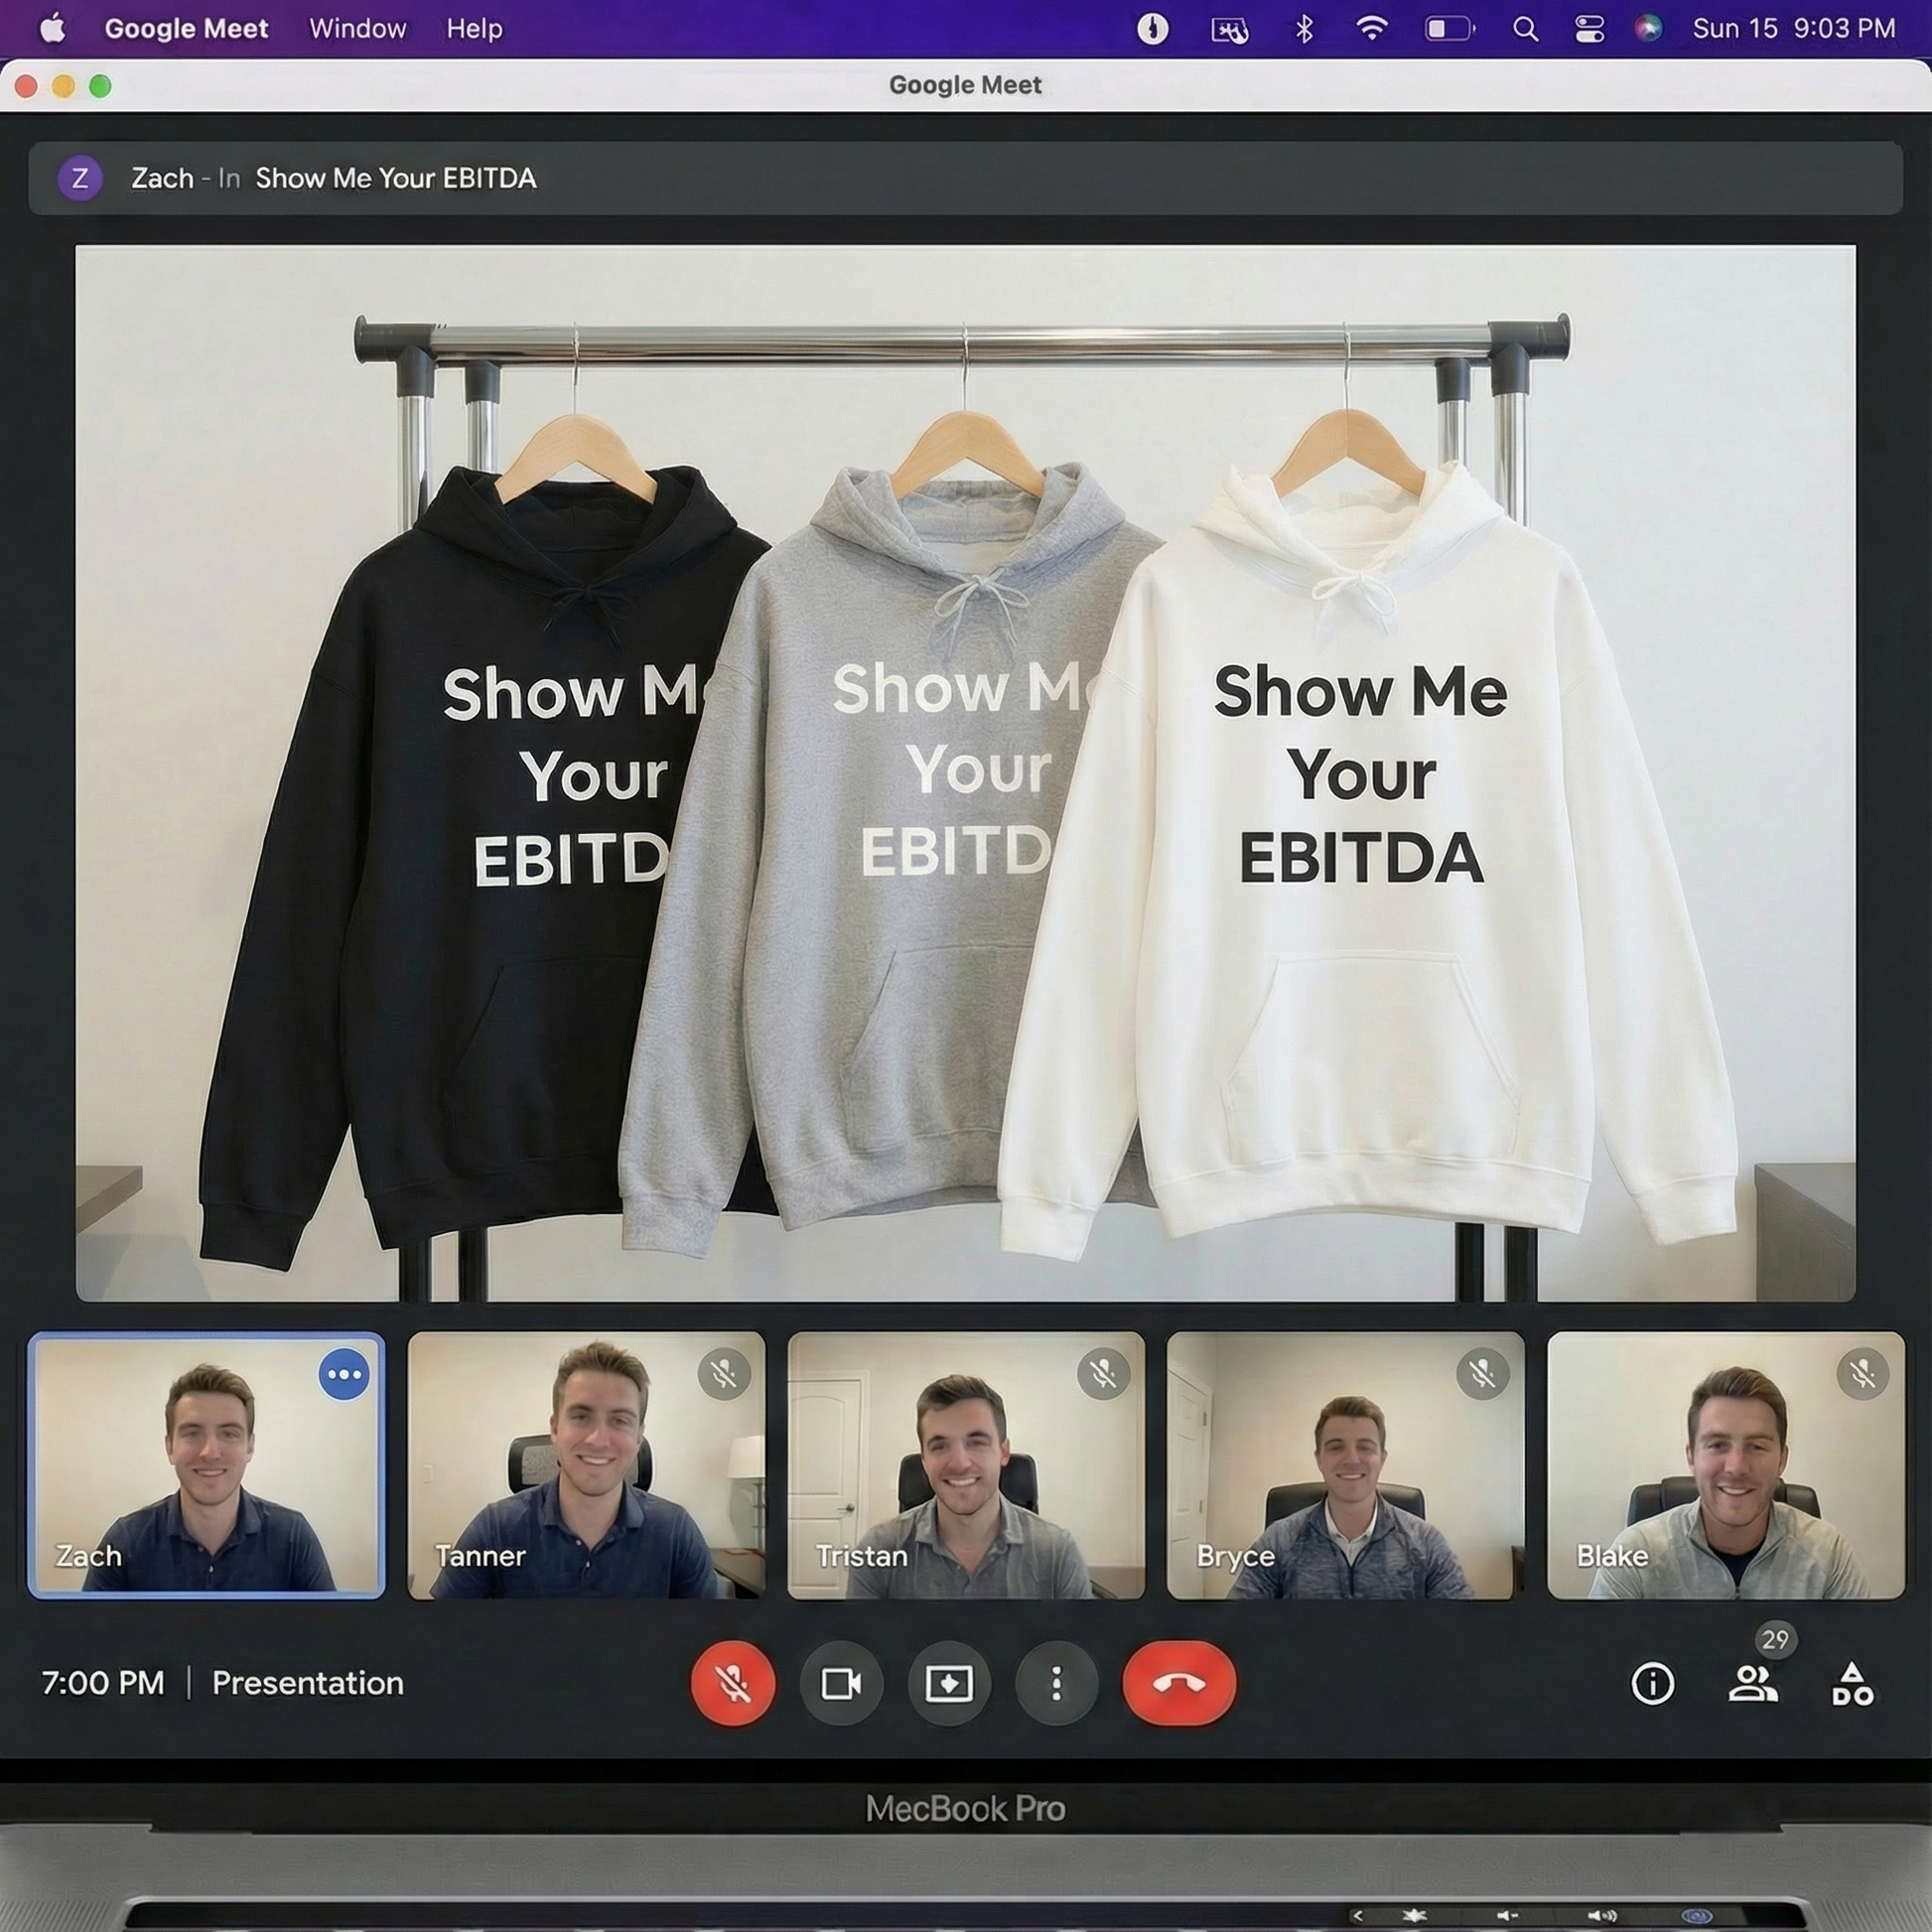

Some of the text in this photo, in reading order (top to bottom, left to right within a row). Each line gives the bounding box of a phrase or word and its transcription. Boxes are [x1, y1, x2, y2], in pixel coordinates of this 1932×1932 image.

[104, 17, 269, 44] Google Meet
[309, 16, 407, 40] Window
[447, 17, 503, 44] Help
[1693, 17, 1896, 40] Sun 15 9:03 PM
[890, 74, 1042, 99] Google Meet
[71, 167, 88, 189] Z
[131, 166, 194, 189] Zach
[219, 167, 240, 189] In
[256, 166, 327, 190] Show
[334, 167, 372, 189] Me
[378, 167, 437, 190] Your
[444, 167, 538, 190] EBITDA
[443, 663, 708, 722] Show M
[833, 660, 1099, 714] Show M
[1214, 662, 1508, 717] Show Me
[518, 750, 669, 802] Your
[905, 743, 1052, 794] Your
[1286, 748, 1438, 800] Your
[475, 831, 669, 888] EBITD
[861, 823, 1052, 878] EBITD
[1241, 831, 1485, 884] EBITDA
[56, 1544, 122, 1568] Zach
[436, 1544, 527, 1568] Tanner
[816, 1544, 908, 1568] Tristan
[1197, 1544, 1276, 1574] Bryce
[1578, 1544, 1649, 1568] Blake
[1761, 1629, 1789, 1650] 29
[42, 1669, 404, 1696] 7:00 PM Presentation
[867, 1793, 1066, 1823] MecBook Pro
